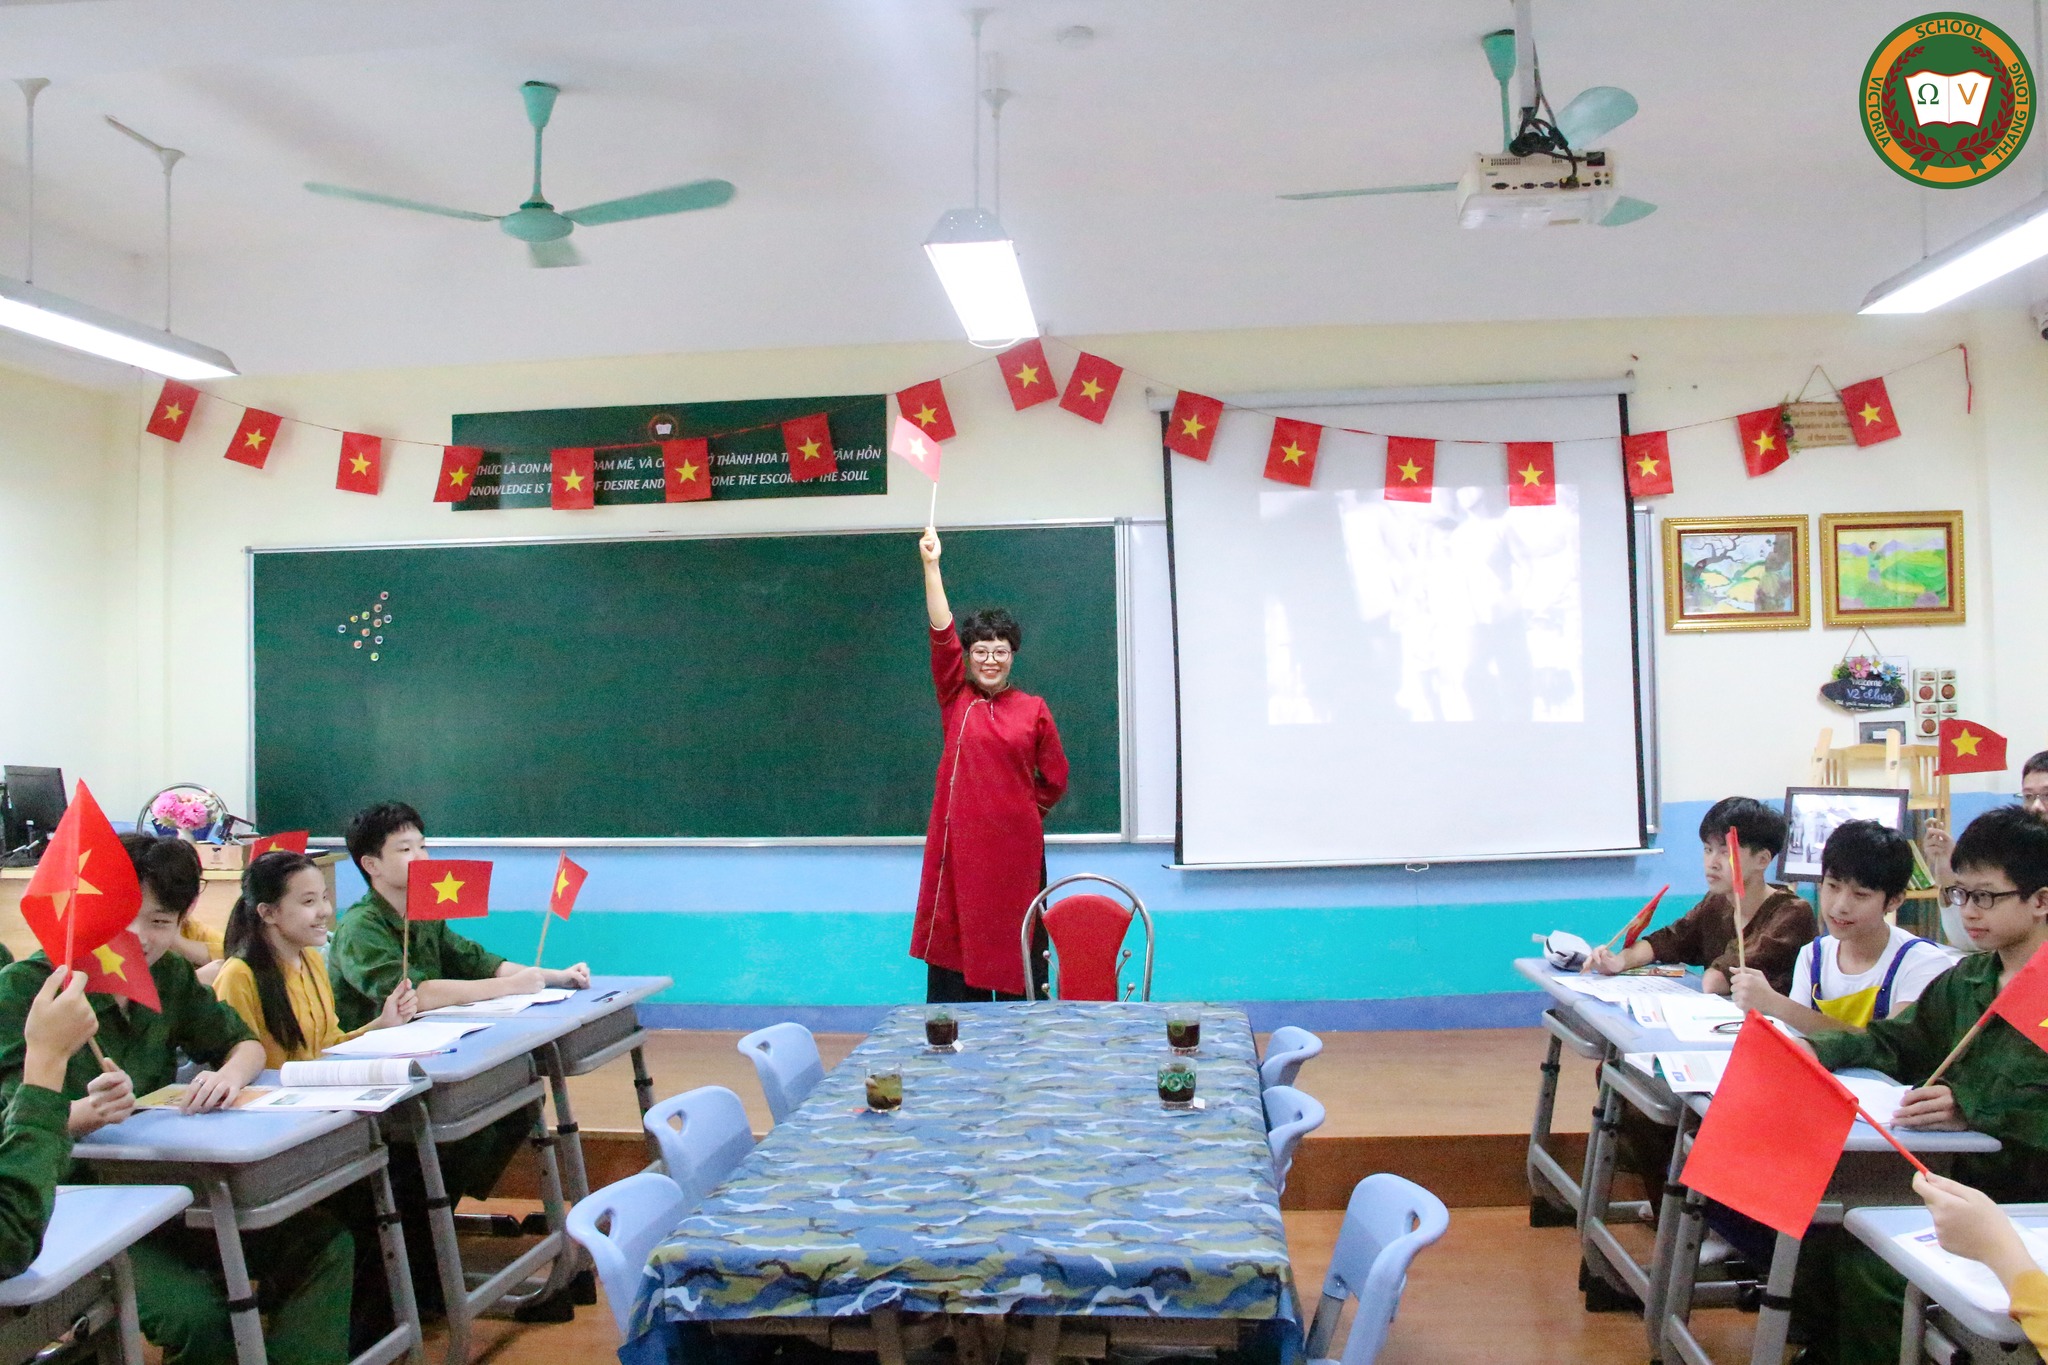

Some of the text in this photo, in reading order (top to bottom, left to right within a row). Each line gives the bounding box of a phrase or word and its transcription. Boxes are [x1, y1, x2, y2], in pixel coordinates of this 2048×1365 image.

[503, 461, 516, 474] LÀ
[518, 463, 540, 474] CON
[639, 455, 653, 469] VÀ
[717, 452, 753, 466] THÀNH
[755, 452, 778, 464] HOA
[469, 483, 534, 496] KNOWLEDGE
[534, 483, 544, 494] IS
[603, 479, 640, 490] DESIRE
[641, 478, 666, 489] AND
[738, 473, 758, 486] THE
[840, 470, 870, 482] SOUL
